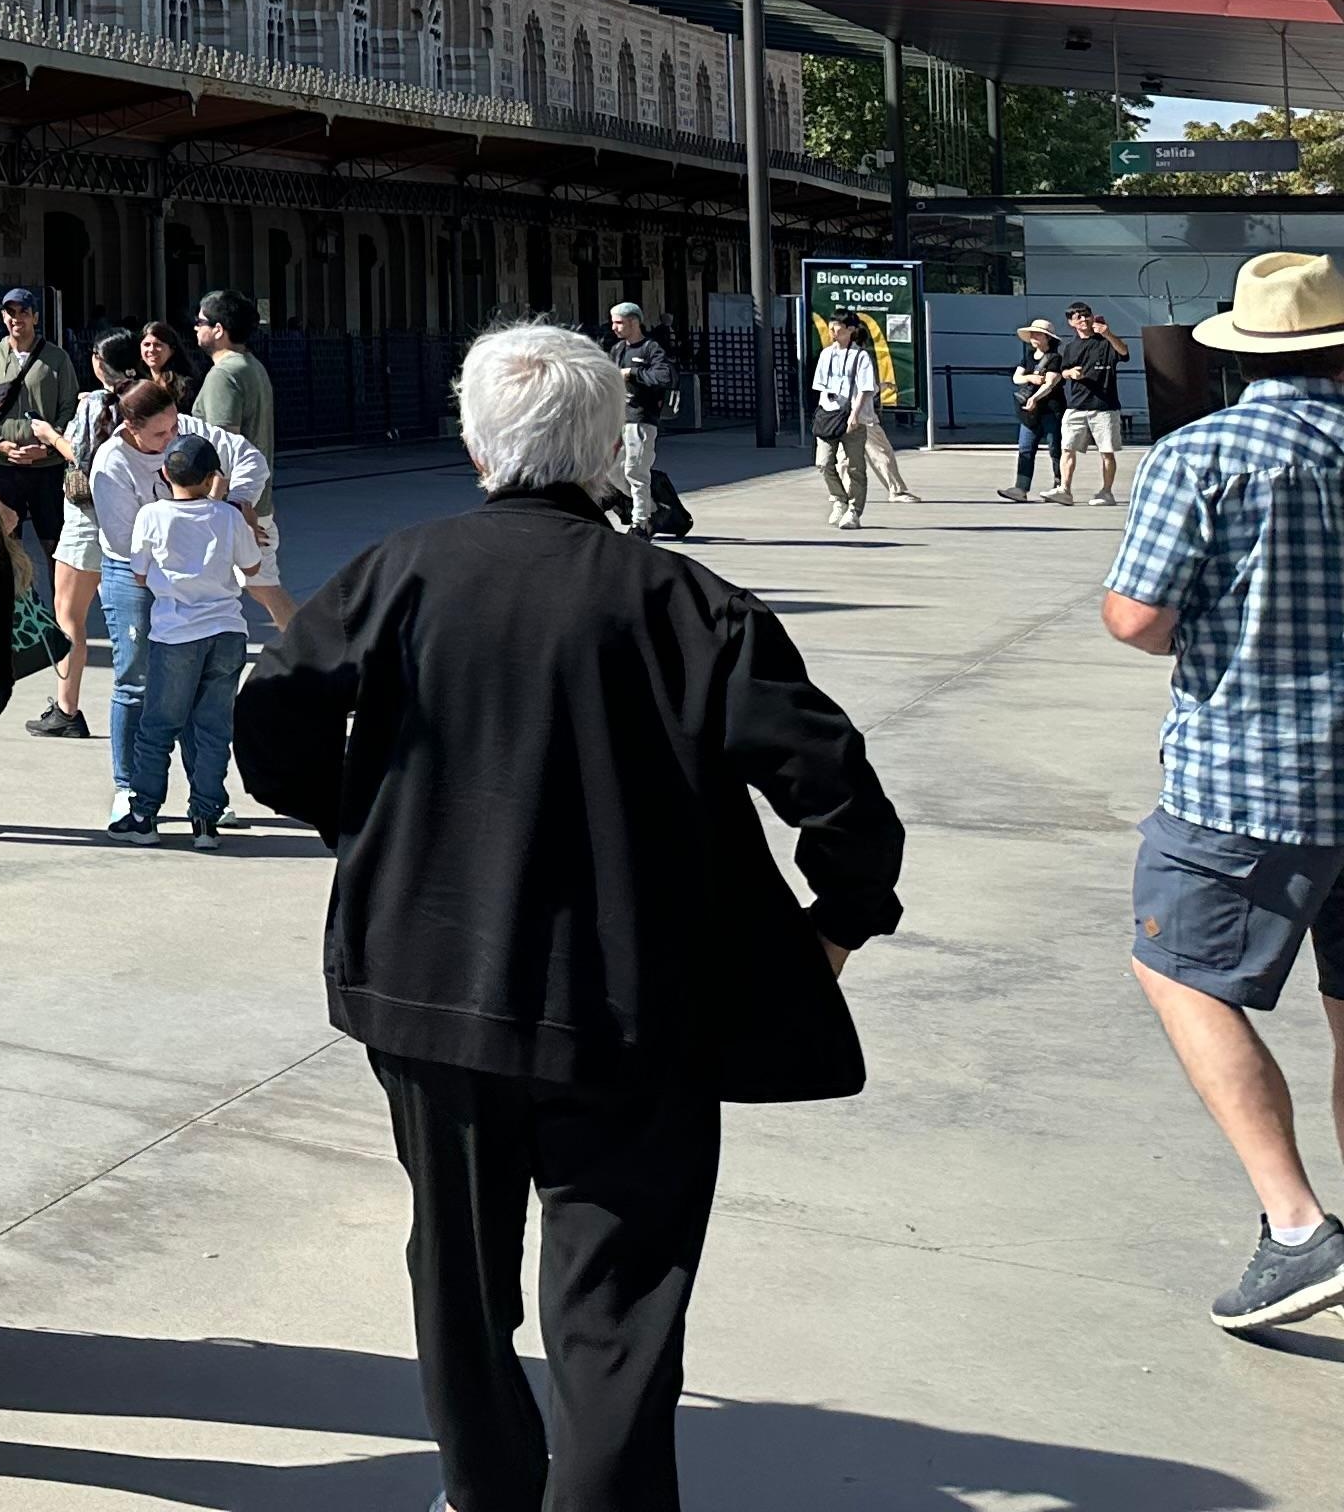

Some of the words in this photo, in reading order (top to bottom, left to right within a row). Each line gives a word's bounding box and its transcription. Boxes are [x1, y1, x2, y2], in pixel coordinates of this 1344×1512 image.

[1155, 147, 1195, 158] Salida
[816, 271, 908, 286] Bienvenidos
[830, 291, 840, 301] a
[843, 289, 893, 302] Toledo
